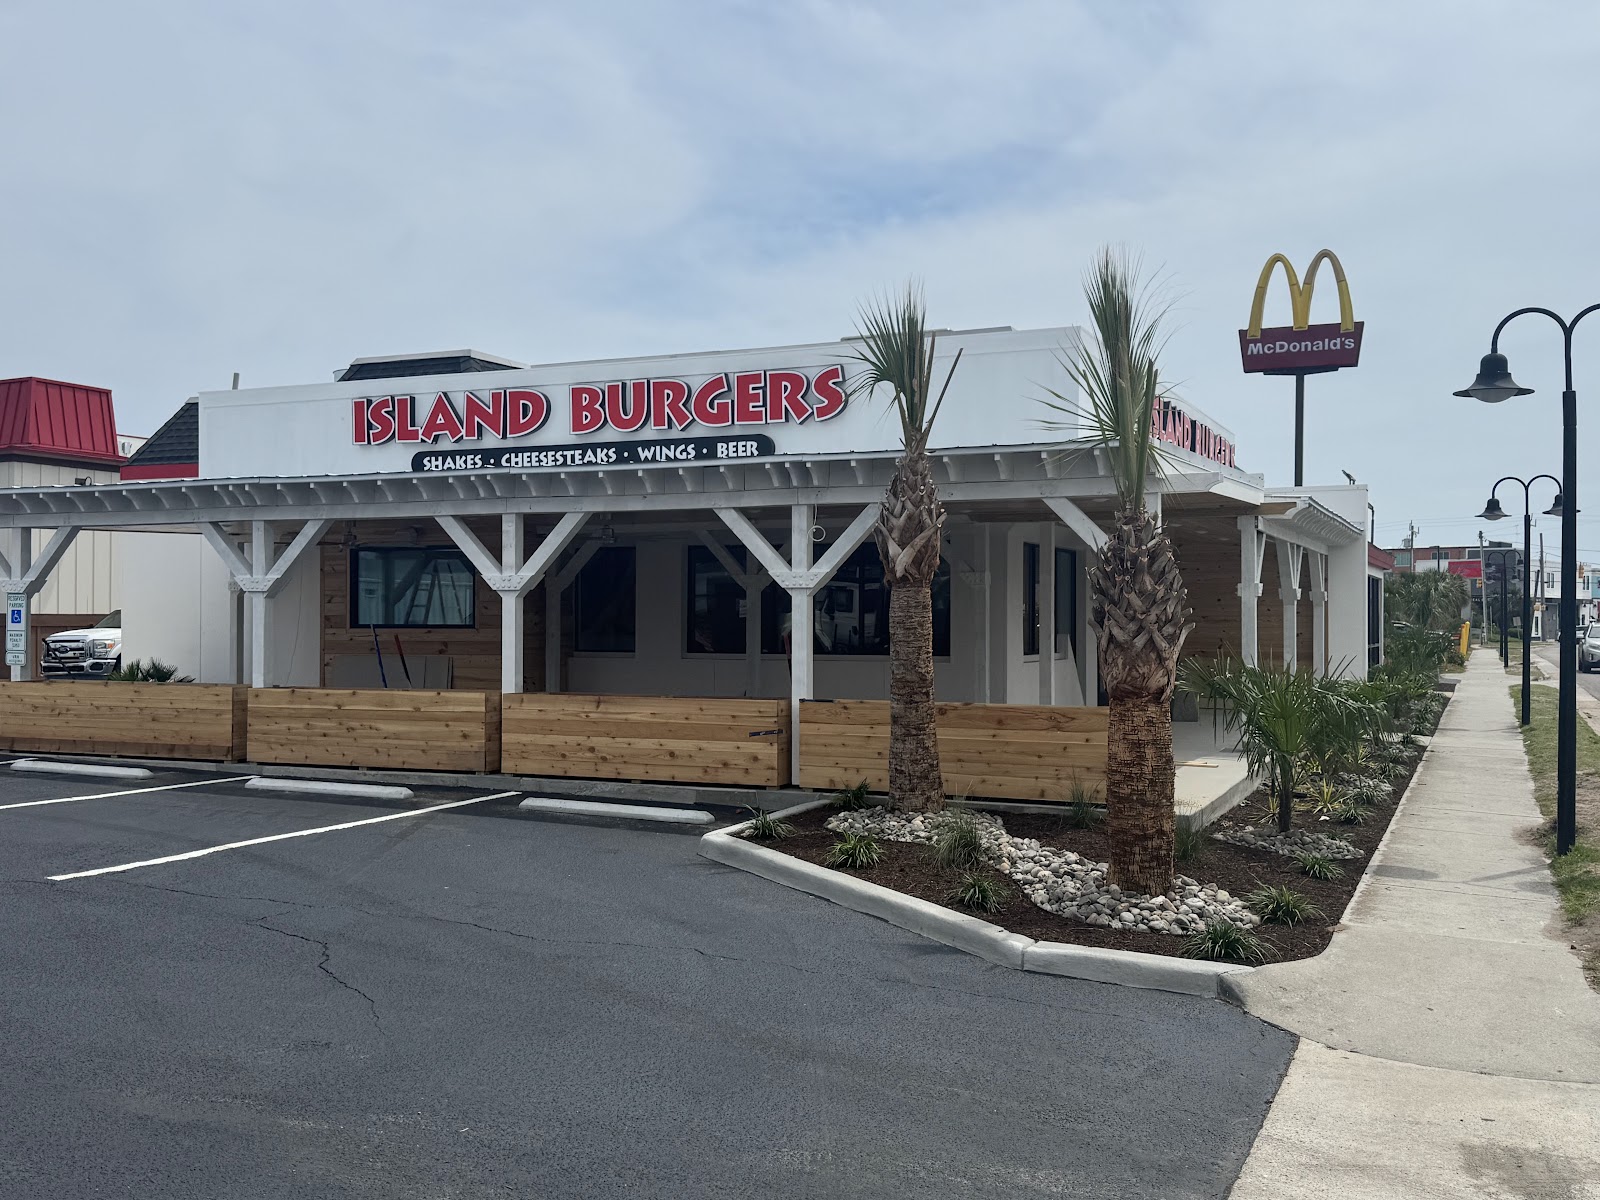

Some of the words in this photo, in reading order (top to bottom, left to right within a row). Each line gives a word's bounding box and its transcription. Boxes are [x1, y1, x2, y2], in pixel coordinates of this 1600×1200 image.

[1246, 337, 1355, 356] McDonald's
[352, 388, 551, 446] ISLAND
[568, 364, 848, 436] BURGERS
[1150, 395, 1192, 452] SLAND
[422, 454, 483, 472] SHAKES
[500, 447, 617, 468] CHEESESTEAKS
[636, 443, 696, 462] WINGS
[716, 440, 759, 459] BEER
